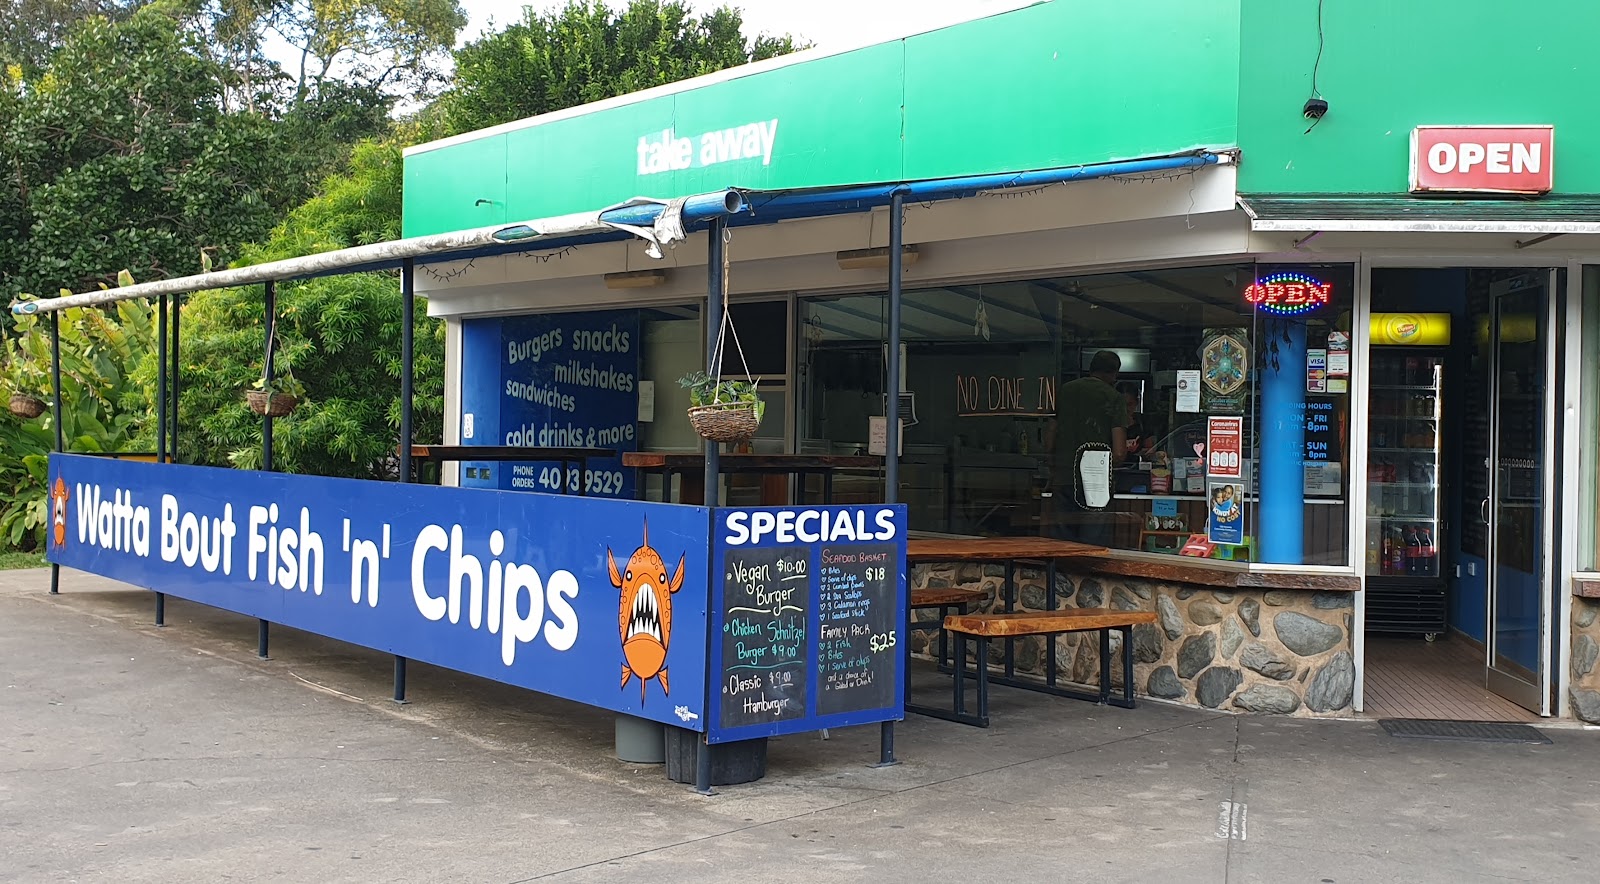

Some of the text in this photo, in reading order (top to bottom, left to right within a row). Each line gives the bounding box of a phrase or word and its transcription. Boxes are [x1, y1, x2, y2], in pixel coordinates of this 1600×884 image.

[637, 118, 778, 176] take away
[1427, 142, 1542, 174] OPEN
[1244, 284, 1330, 302] OPEN
[508, 323, 630, 365] Burgers snacks
[554, 359, 634, 393] milkshakes
[505, 379, 576, 412] sandwiches
[957, 375, 1055, 411] NO DINE IN
[1307, 421, 1328, 432] 8pm
[1314, 414, 1327, 422] FRI
[505, 422, 634, 448] cold drinks & more
[1307, 442, 1327, 450] SUN
[512, 477, 535, 488] ORDERS
[513, 465, 534, 476] PHONE
[584, 469, 623, 495] 9529
[725, 509, 896, 545] SPECIALS
[1226, 510, 1241, 522] COST
[822, 548, 887, 564] SEAFOOD BASKET
[76, 482, 579, 666] Watta Bout Fish 'n' Chips
[732, 560, 771, 594] Vegan
[865, 567, 885, 582] $18
[756, 584, 795, 616] Burger
[827, 602, 831, 610] 3
[732, 615, 805, 647] Chicken Schnitzel
[851, 623, 870, 637] PACK
[869, 630, 896, 654] $25
[735, 641, 768, 665] Burger
[827, 641, 831, 649] 2
[729, 674, 761, 695] Classic
[743, 691, 789, 716] Hamburger
